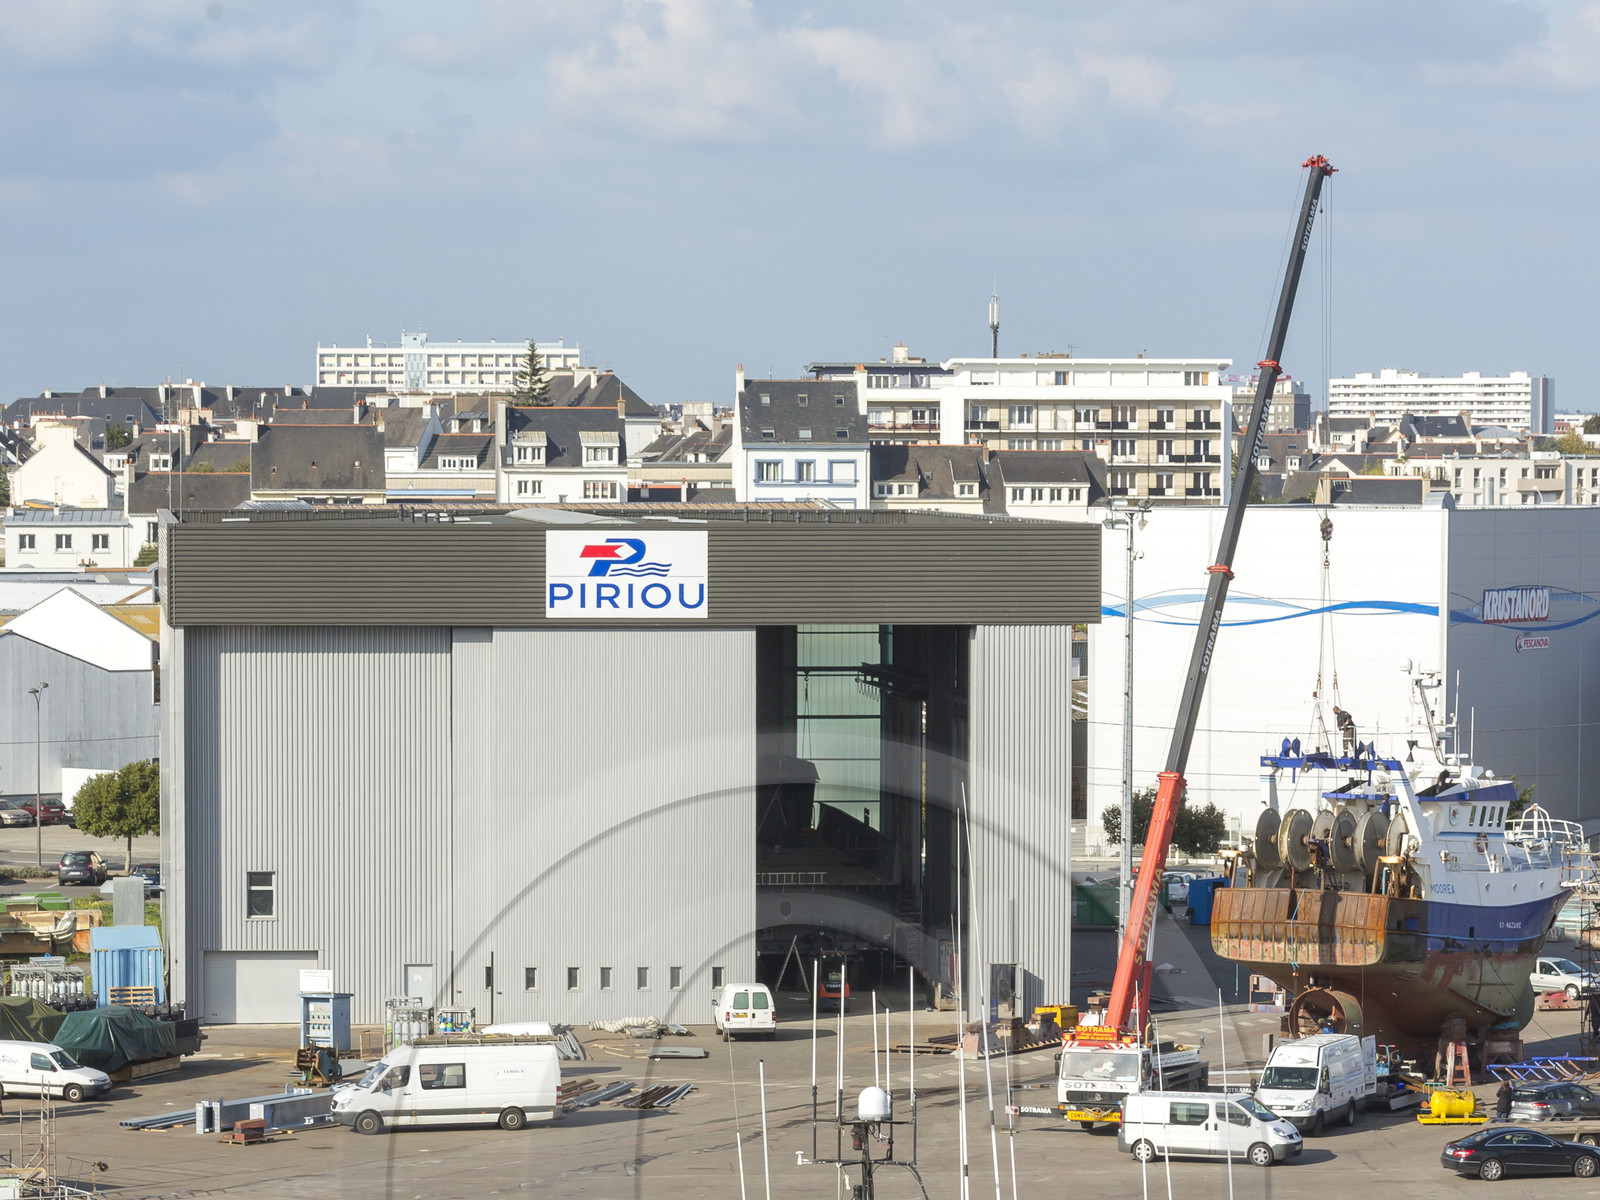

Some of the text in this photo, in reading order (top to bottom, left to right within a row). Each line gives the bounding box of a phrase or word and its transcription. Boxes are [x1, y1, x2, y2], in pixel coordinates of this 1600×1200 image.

[1301, 199, 1318, 252] SOTRAMA
[1251, 398, 1272, 466] SOTRAMA
[549, 583, 704, 609] PIRIOU
[1484, 588, 1550, 623] KRUSTANORD
[1201, 610, 1222, 674] SOTRAMA
[1523, 638, 1549, 649] PESCANOVA
[1430, 883, 1456, 895] MOOREA
[1134, 868, 1164, 966] SOTRAMA
[1020, 1106, 1052, 1114] SOTRAMA
